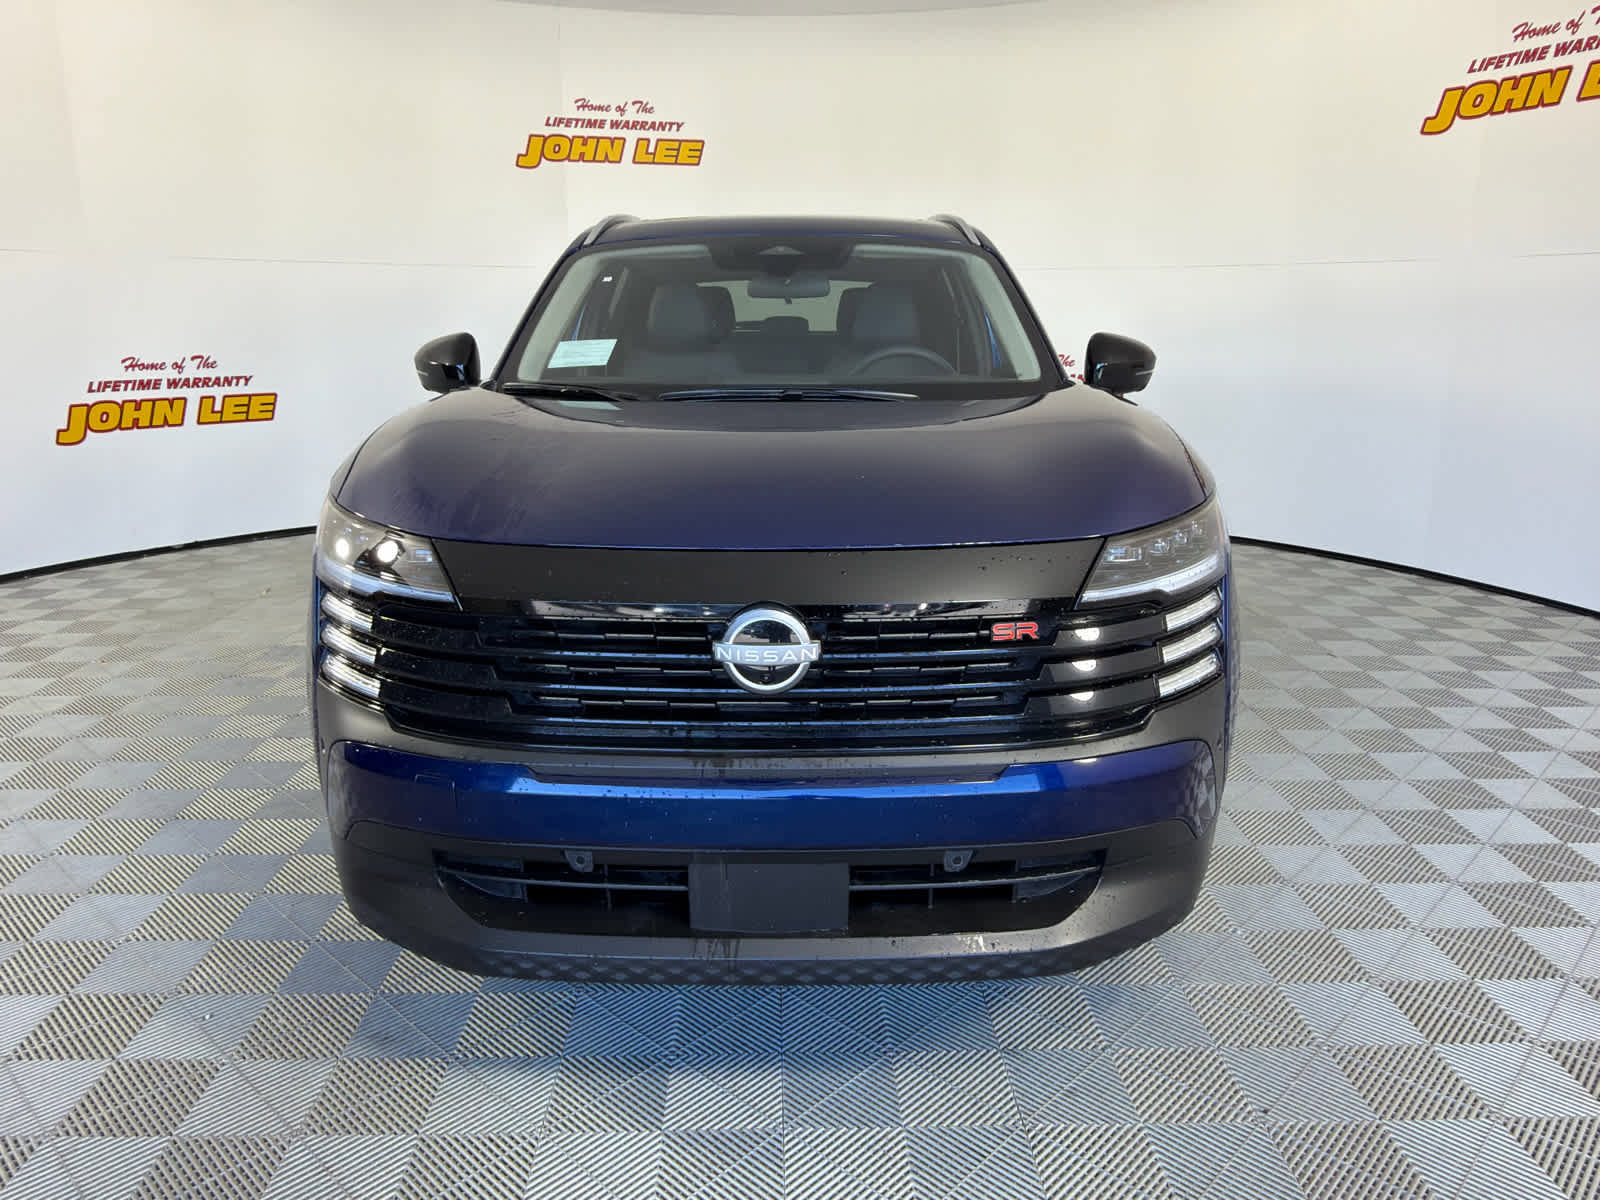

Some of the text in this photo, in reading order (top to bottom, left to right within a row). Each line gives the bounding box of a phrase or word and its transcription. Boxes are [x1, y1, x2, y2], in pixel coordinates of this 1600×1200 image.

[1512, 22, 1561, 42] Home
[1565, 10, 1586, 35] of
[1467, 45, 1551, 73] LIFETIME
[574, 98, 655, 117] Home of The
[1420, 65, 1573, 135] JOHN
[545, 116, 684, 132] LIFETIME WARRANTY
[516, 134, 705, 169] JOHN LEE
[121, 355, 218, 374] Home of The
[87, 375, 253, 393] LIFETIME WARRANTY
[55, 393, 278, 446] JOHN LEE
[992, 621, 1040, 641] SR
[715, 646, 818, 663] NISSAN
